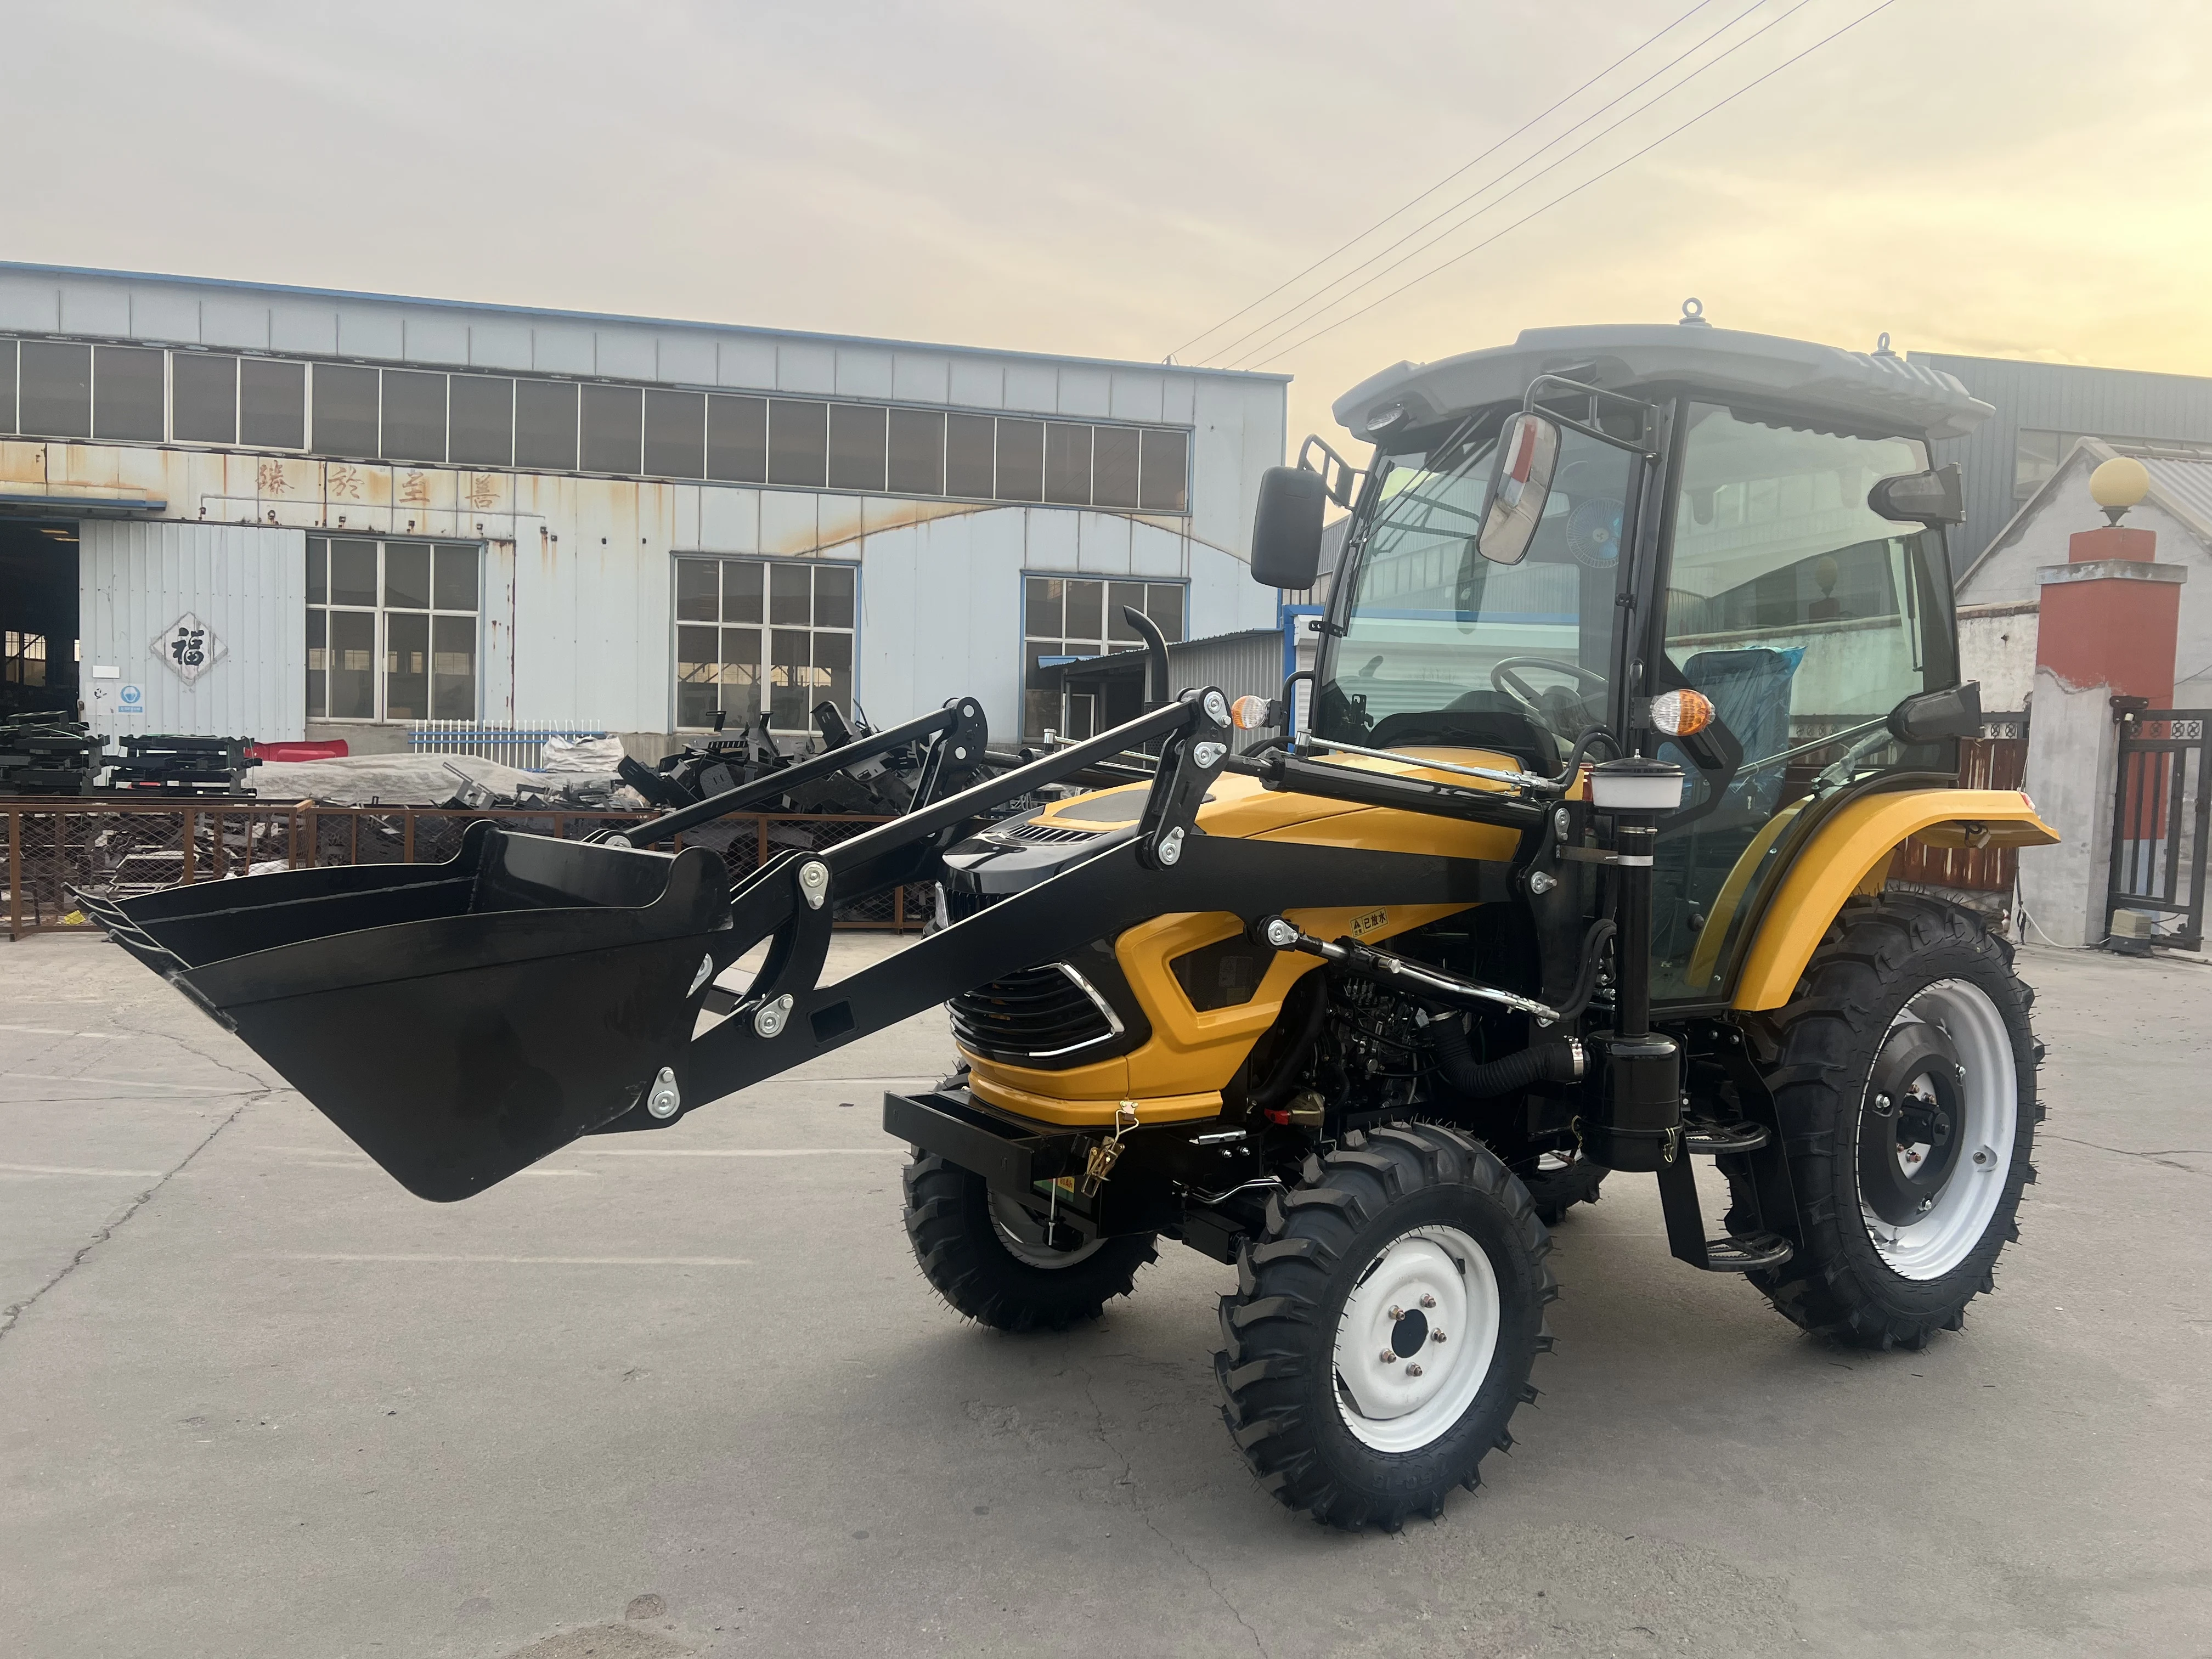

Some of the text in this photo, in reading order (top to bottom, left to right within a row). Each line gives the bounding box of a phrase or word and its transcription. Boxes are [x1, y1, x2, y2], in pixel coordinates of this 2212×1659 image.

[171, 627, 205, 666] 福
[1364, 911, 1386, 929] 已放水
